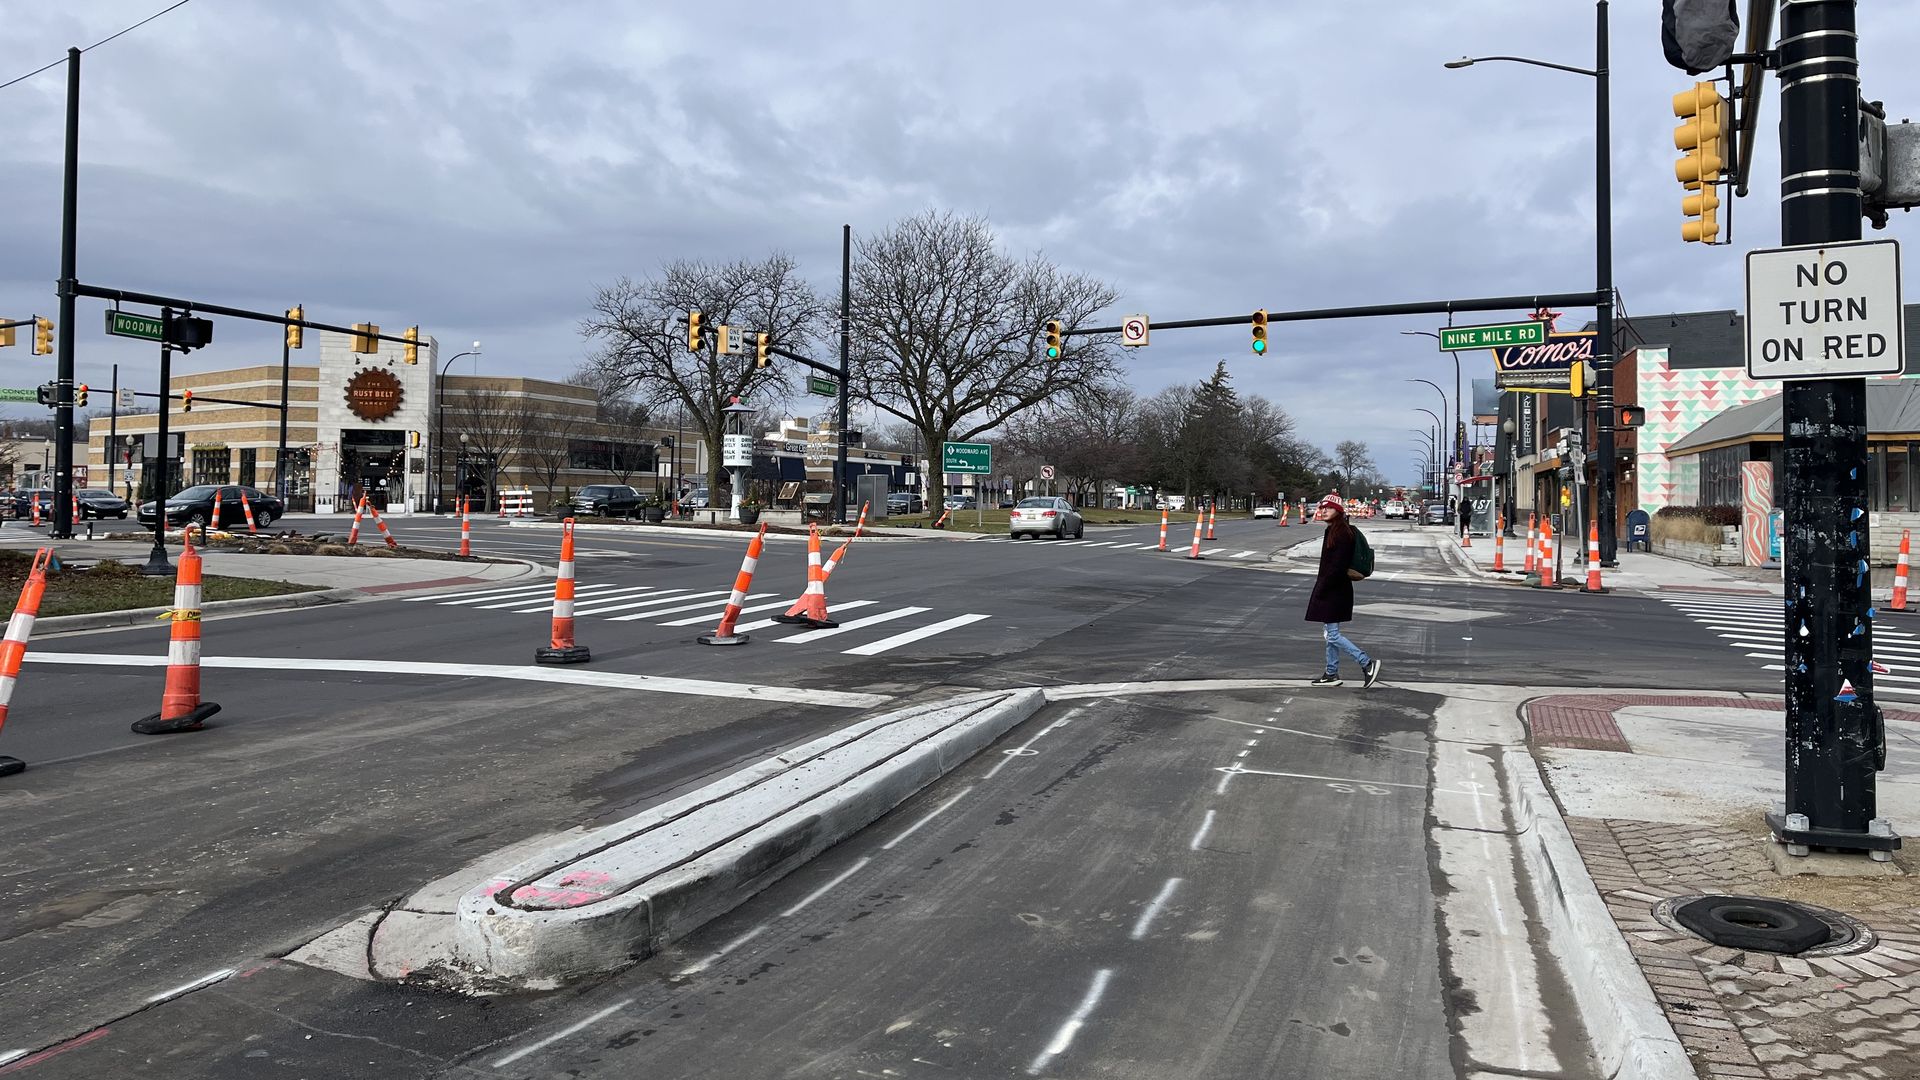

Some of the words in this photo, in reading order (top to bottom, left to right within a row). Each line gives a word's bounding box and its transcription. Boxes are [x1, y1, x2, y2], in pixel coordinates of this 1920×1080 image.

[1796, 260, 1848, 288] NO
[1779, 296, 1867, 325] TURN
[1447, 333, 1476, 345] NINE
[1482, 330, 1513, 342] MILE
[1519, 328, 1536, 339] RD
[1762, 337, 1804, 363] ON
[1823, 333, 1887, 360] RED
[1502, 337, 1595, 368] Como's
[2, 388, 37, 396] CONCER
[374, 390, 394, 398] BELT
[1523, 394, 1532, 448] TERRITORY
[955, 447, 979, 455] WOODWARD
